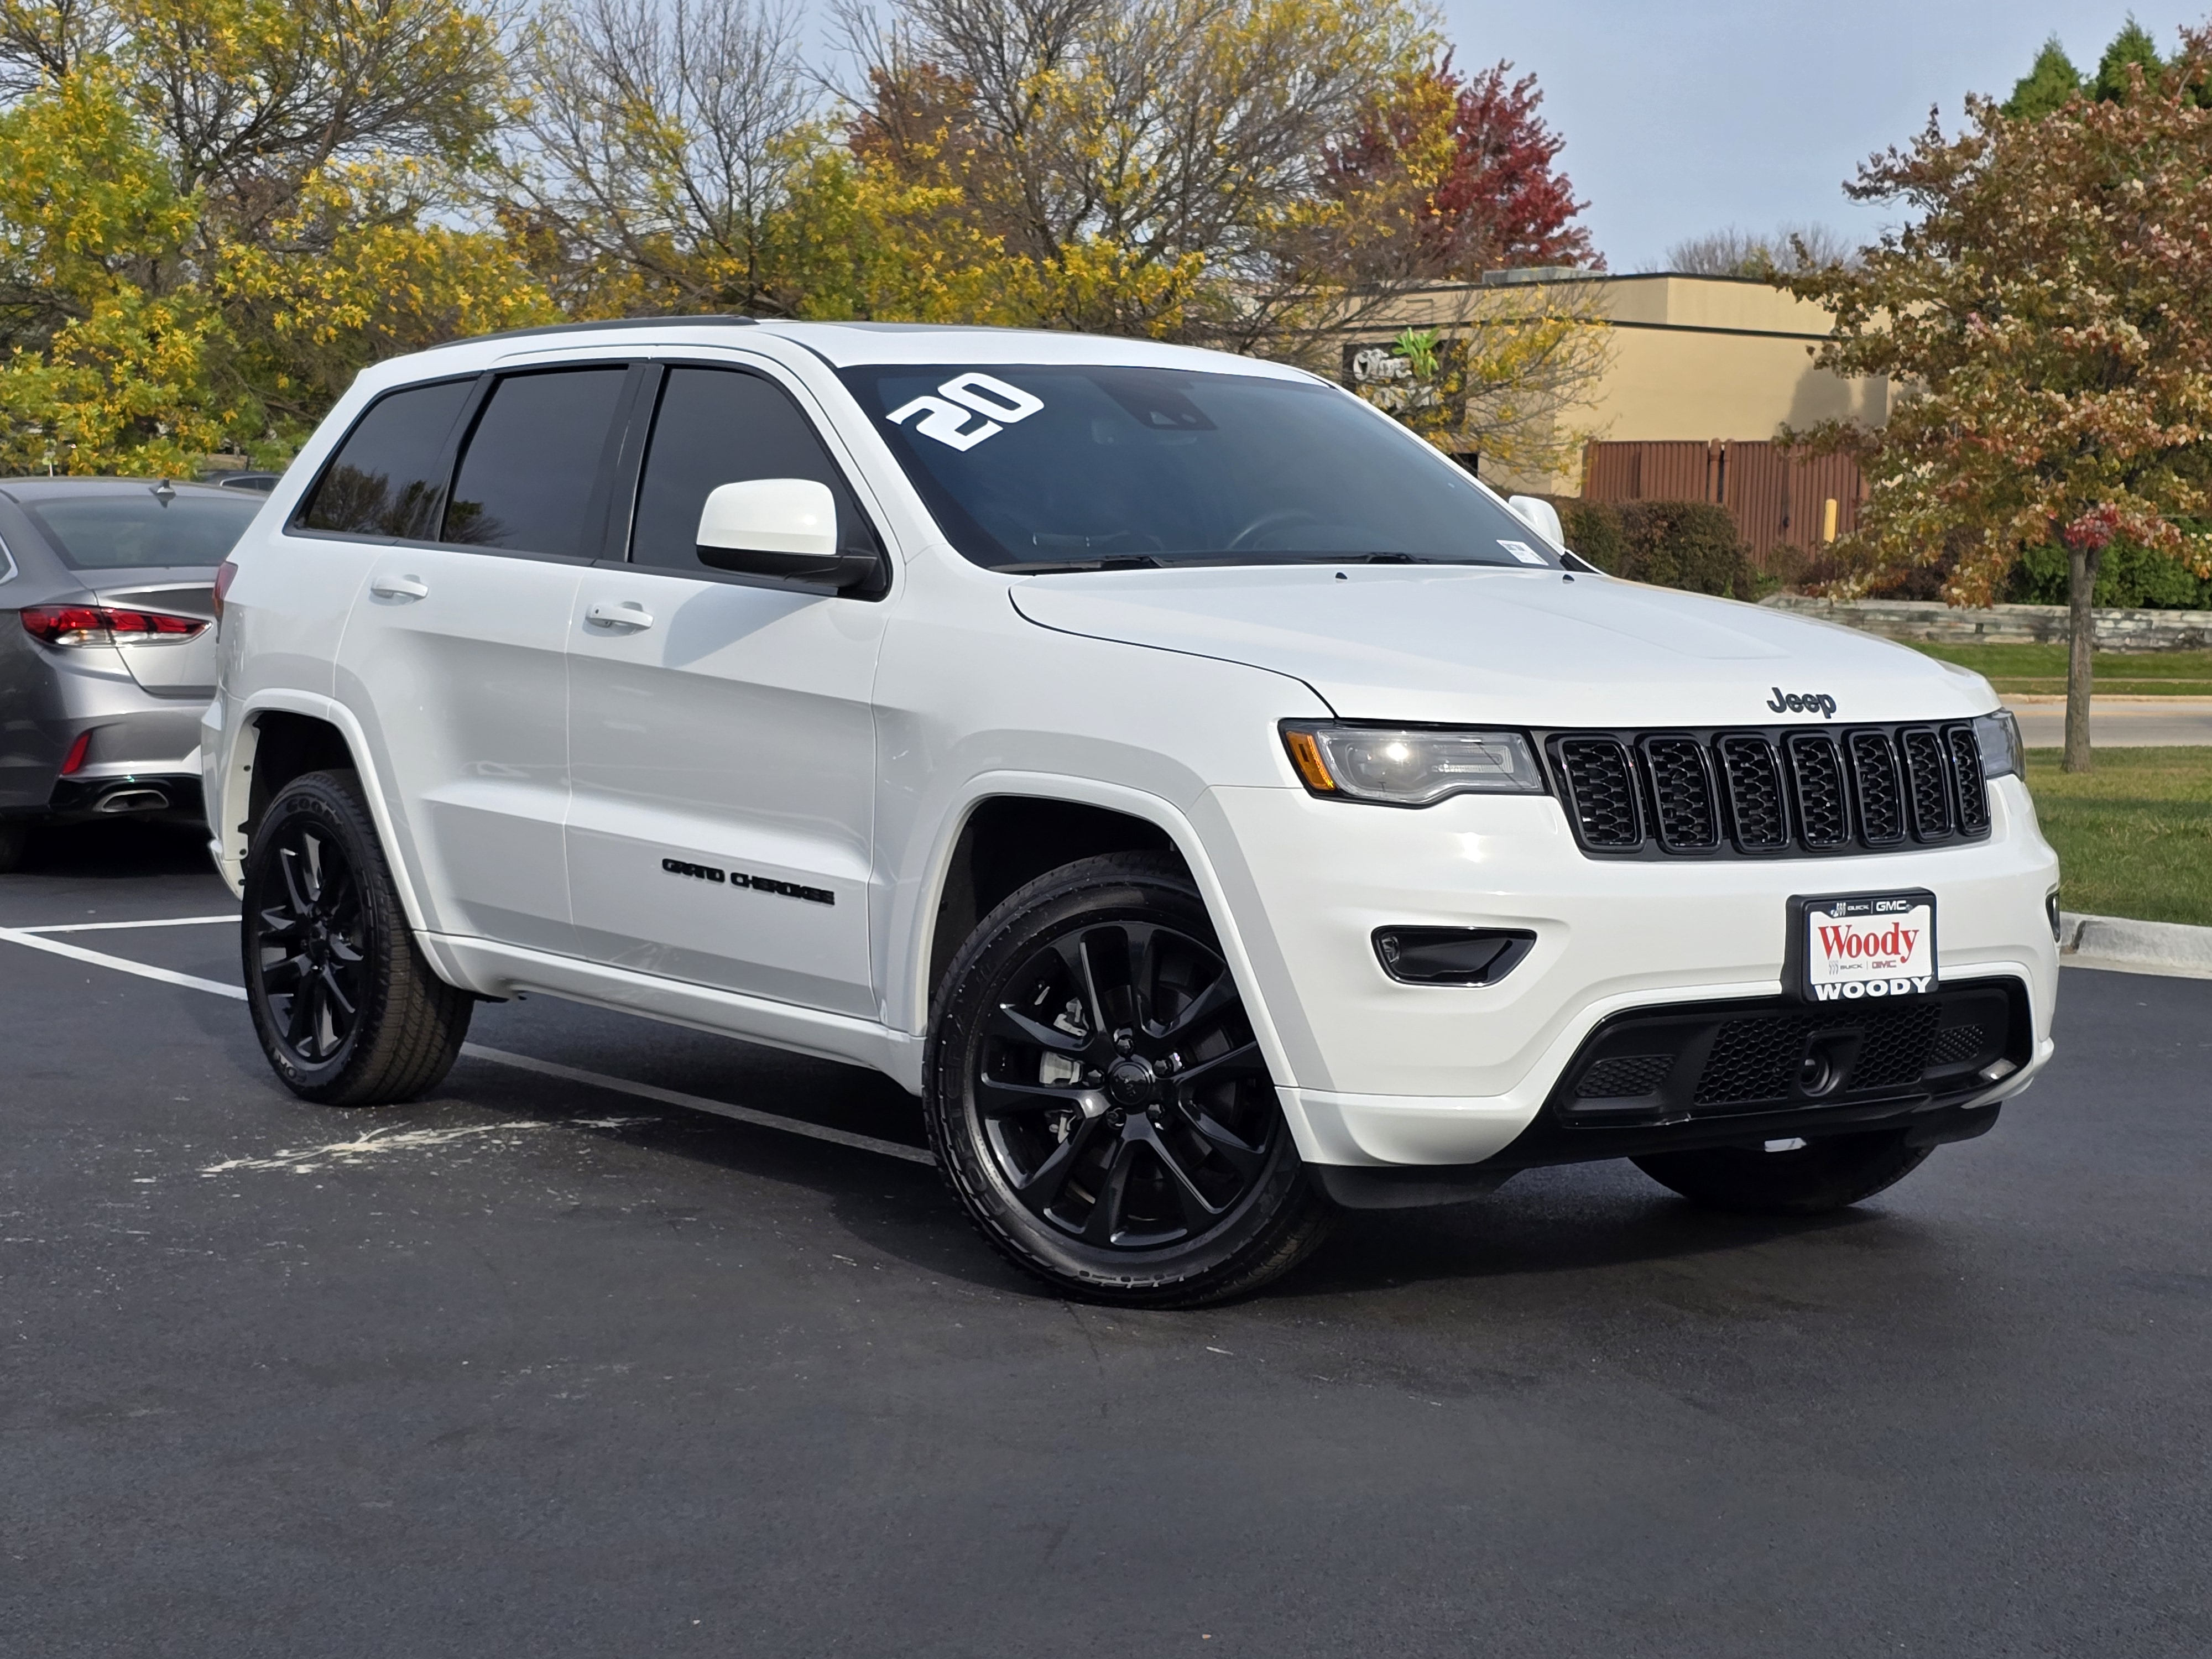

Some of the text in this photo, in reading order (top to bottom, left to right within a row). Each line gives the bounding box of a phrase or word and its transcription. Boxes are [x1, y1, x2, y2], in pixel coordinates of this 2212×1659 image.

[885, 372, 1045, 452] 20
[1766, 687, 1837, 719] Jeep
[662, 858, 835, 906] GRAND CHEROKEE
[1876, 900, 1907, 912] GMC
[1817, 921, 1920, 964] Woody
[1871, 959, 1897, 969] GMC
[1814, 976, 1932, 1001] WOODY
